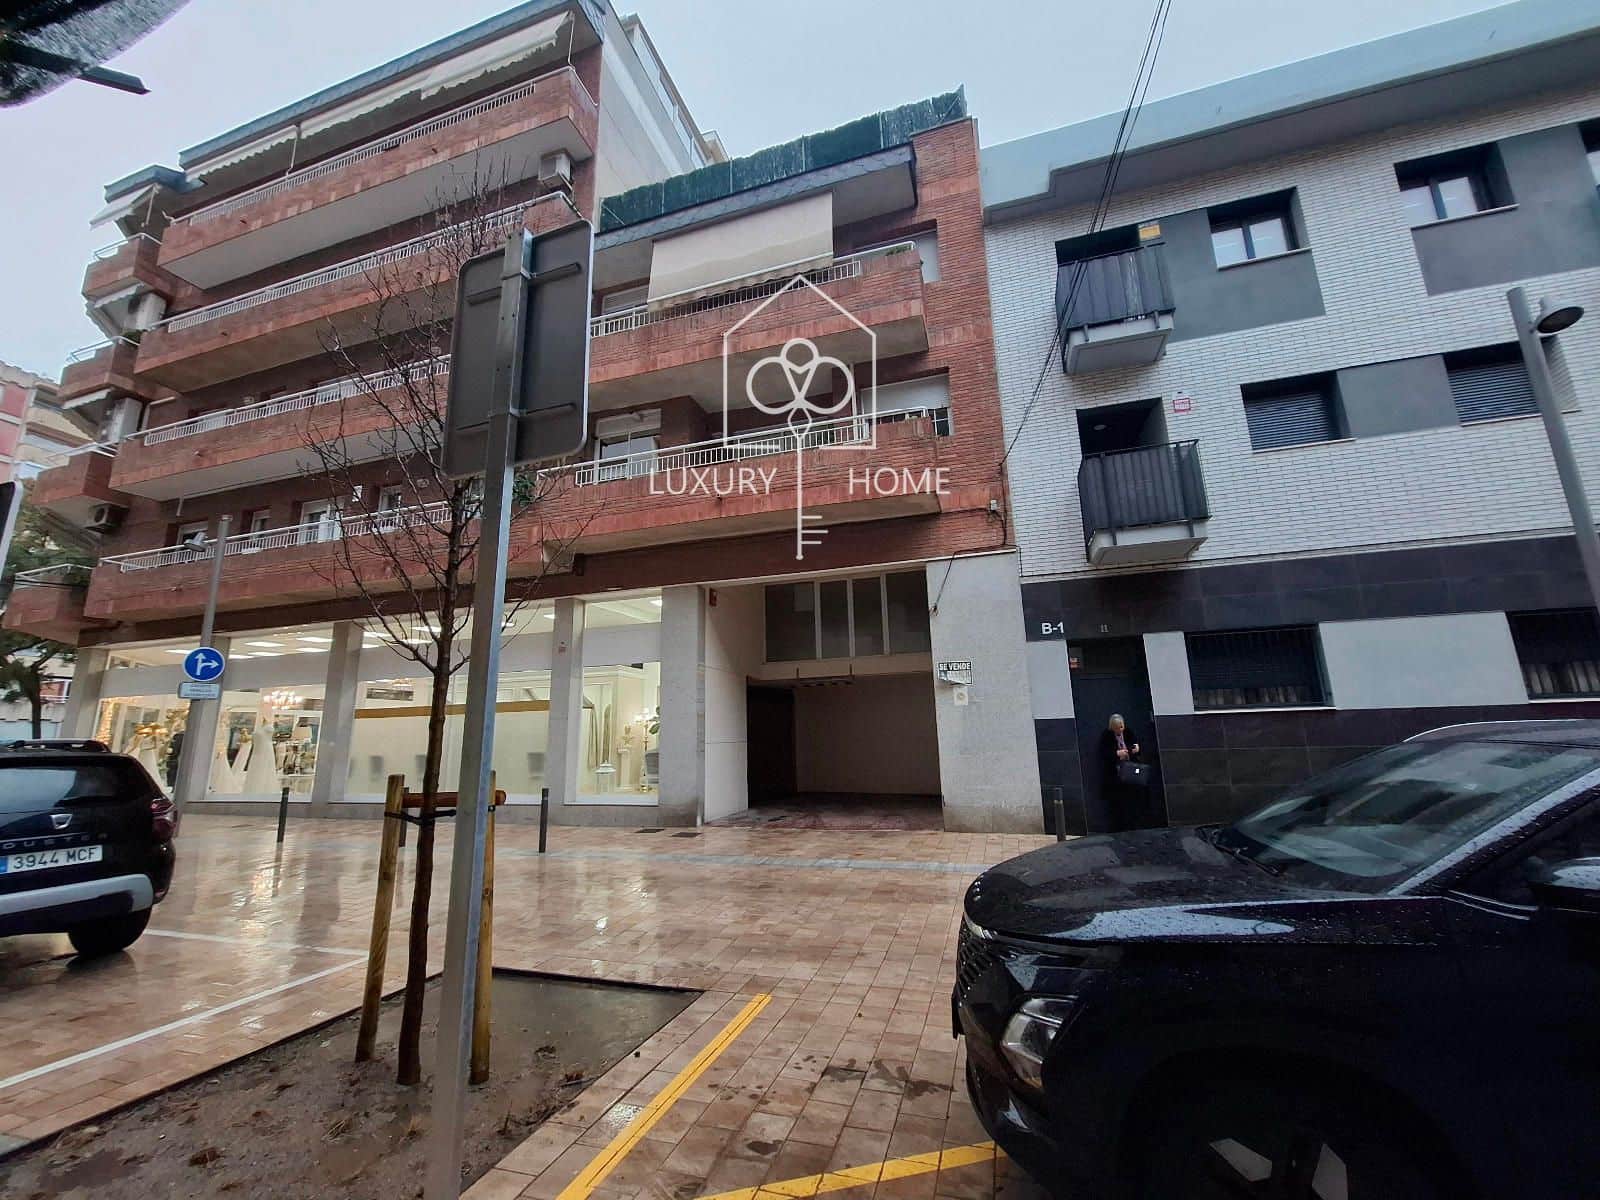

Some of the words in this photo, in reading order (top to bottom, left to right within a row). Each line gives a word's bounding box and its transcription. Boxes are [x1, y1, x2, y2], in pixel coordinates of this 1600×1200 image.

[1041, 622, 1064, 635] B-1
[939, 663, 948, 671] SE
[948, 662, 971, 670] VENDE
[13, 851, 59, 869] 3944
[66, 847, 97, 863] MCF
